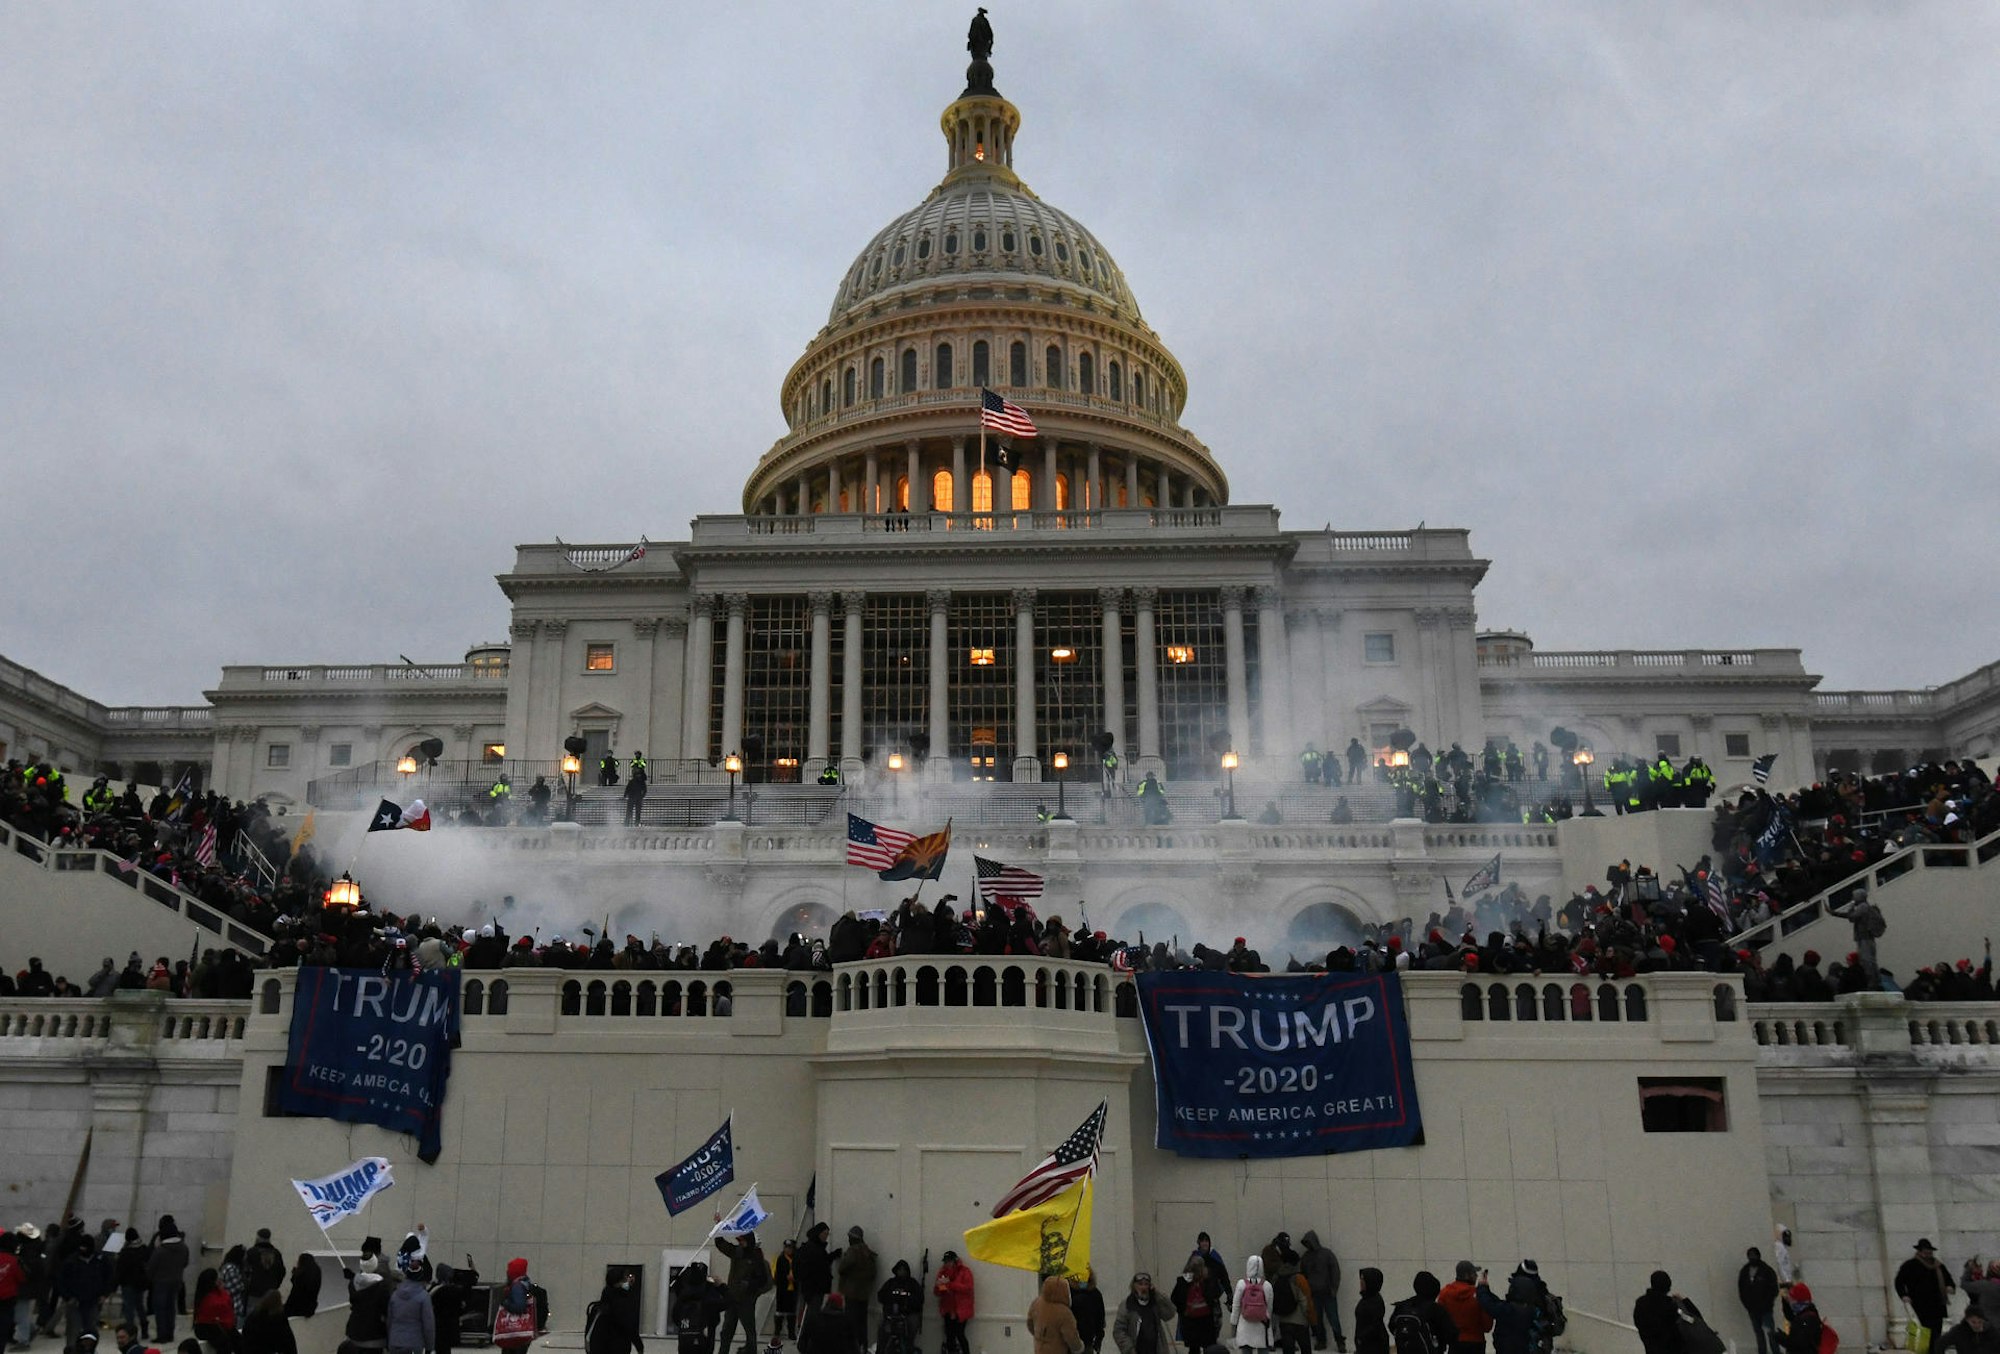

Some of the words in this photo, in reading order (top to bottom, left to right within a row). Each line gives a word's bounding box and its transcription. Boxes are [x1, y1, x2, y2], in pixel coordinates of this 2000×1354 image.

[1164, 995, 1375, 1051] TRUMP
[357, 1034, 427, 1070] -220
[1224, 1064, 1334, 1094] -2020-
[1174, 1105, 1219, 1121] KEEP
[1228, 1105, 1315, 1121] AMERICA
[1323, 1096, 1395, 1116] GREAT!
